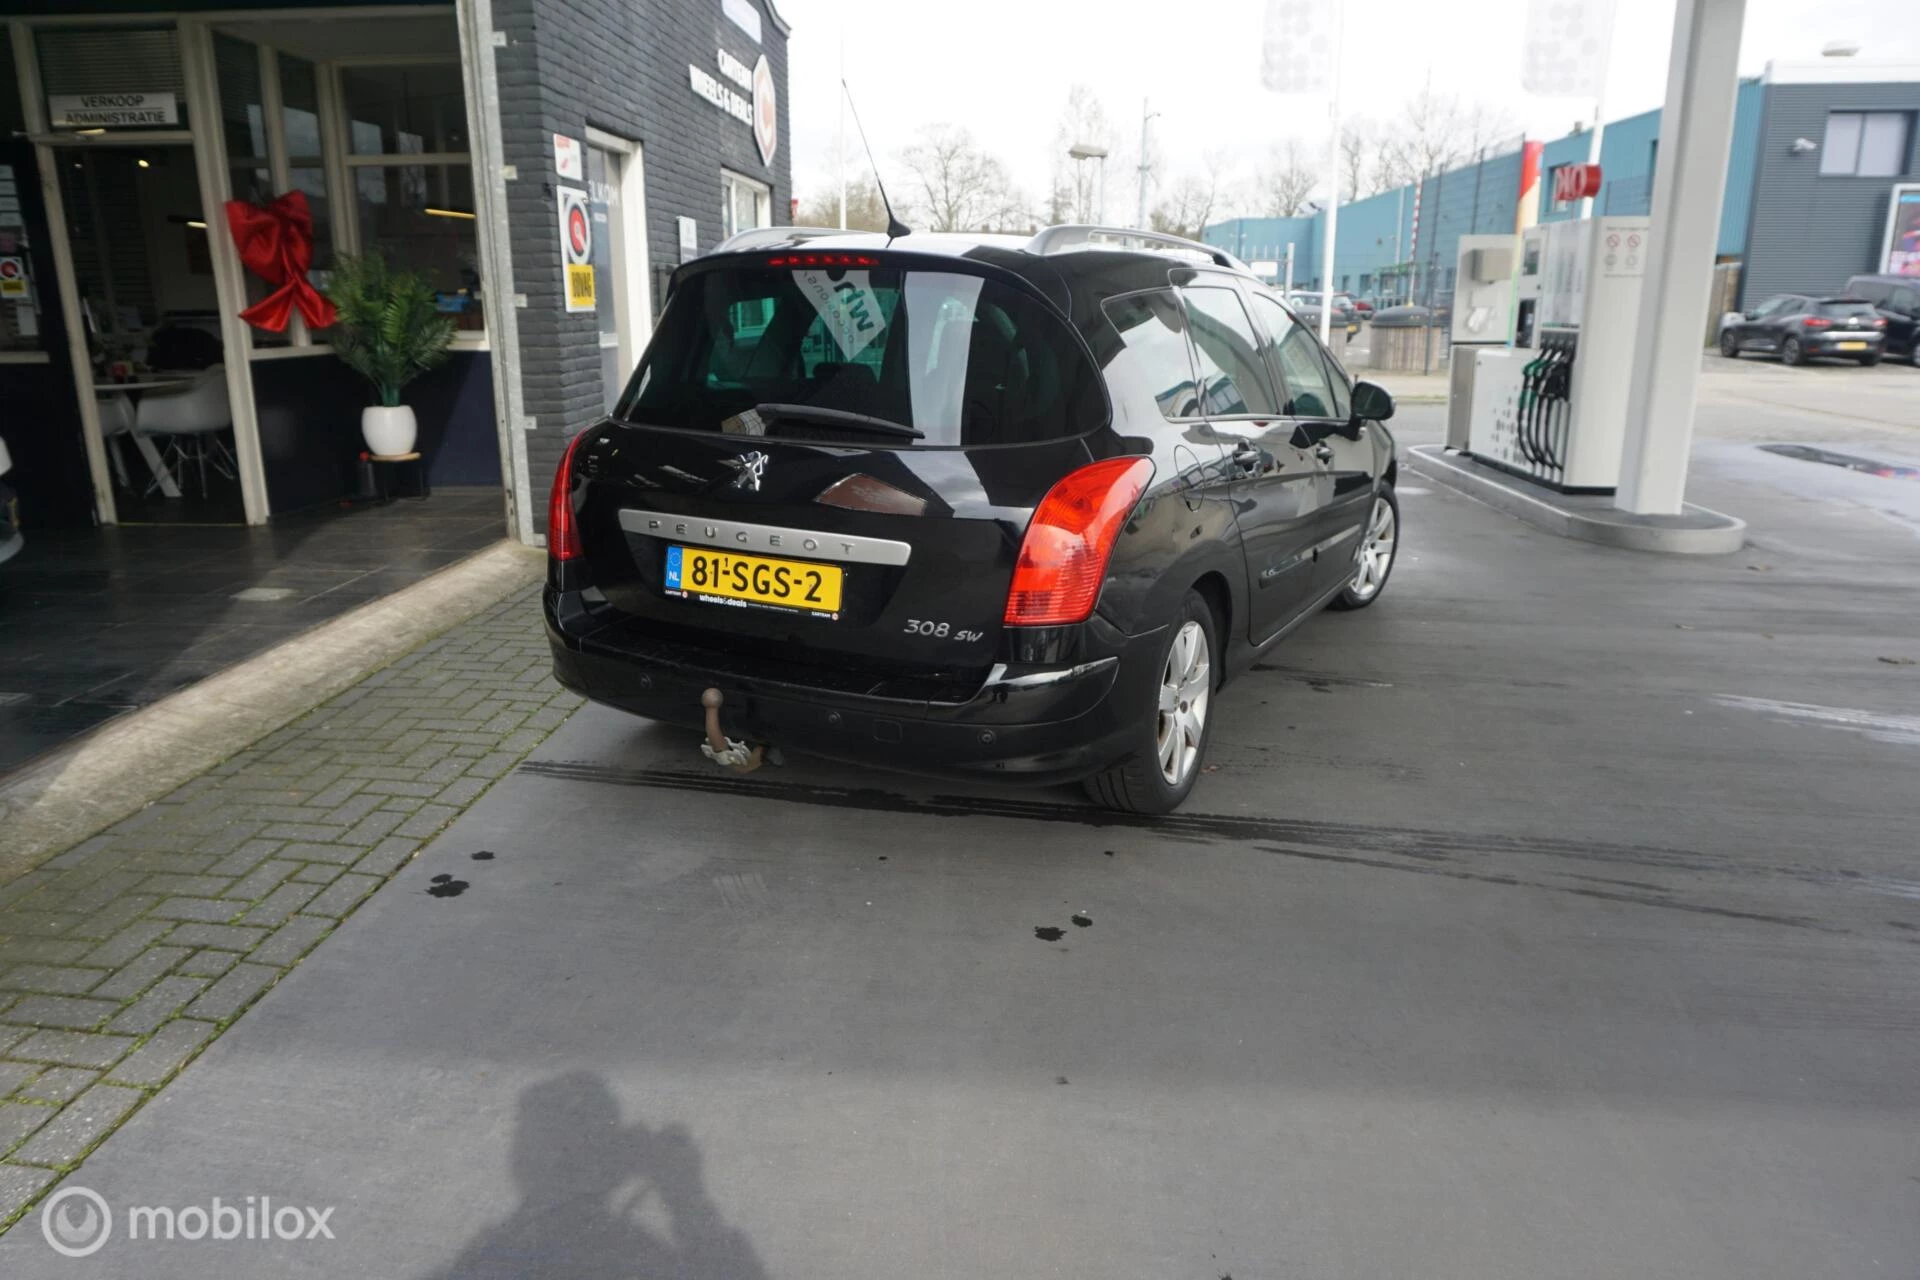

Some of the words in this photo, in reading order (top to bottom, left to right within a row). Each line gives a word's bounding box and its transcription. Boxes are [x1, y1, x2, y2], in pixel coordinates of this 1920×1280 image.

[81, 95, 144, 108] VERKOOP
[65, 111, 165, 123] ADMINISTRATIE
[648, 519, 856, 555] PEUGEOT
[668, 569, 680, 582] NL
[691, 555, 823, 603] 81-SGS-2
[904, 619, 950, 638] 308
